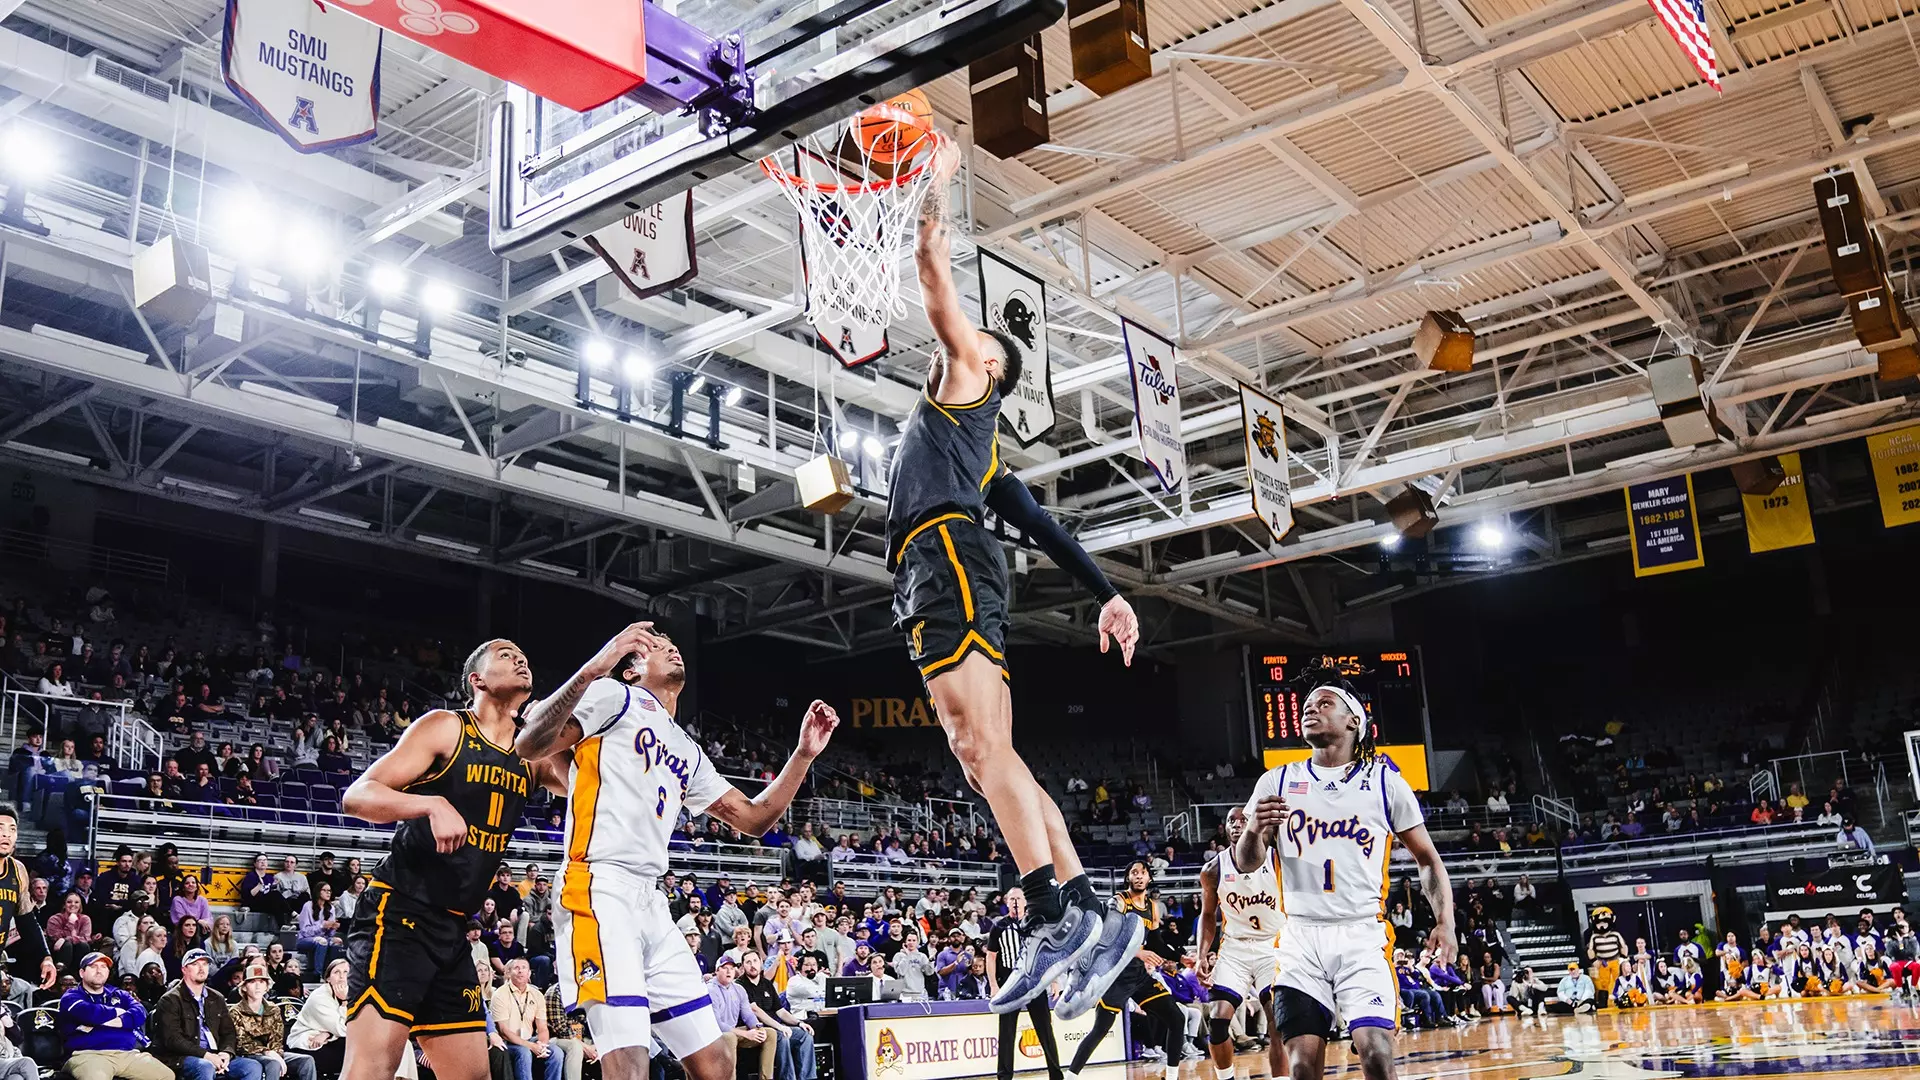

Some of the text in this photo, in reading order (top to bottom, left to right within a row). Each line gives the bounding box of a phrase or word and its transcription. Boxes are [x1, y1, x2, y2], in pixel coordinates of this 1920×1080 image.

[288, 28, 328, 62] SMU
[258, 41, 354, 98] MUSTANGS
[623, 216, 657, 240] OWLS
[1138, 361, 1175, 398] Tulsa
[1022, 385, 1044, 407] WAVE
[1648, 487, 1669, 499] MARY
[1763, 496, 1789, 510] 1973
[1650, 527, 1679, 538] 1ST TEAM
[1263, 655, 1287, 664] PIRATES
[1397, 663, 1410, 676] 17
[1271, 667, 1283, 680] 18
[1291, 692, 1297, 702] 2
[851, 697, 940, 728] PIRA
[466, 763, 527, 797] WICHITA
[486, 791, 504, 828] 11
[468, 824, 509, 853] STATE
[1287, 809, 1375, 860] Pirates
[1323, 858, 1335, 893] 1
[1226, 890, 1277, 914] Pirates
[1778, 886, 1805, 896] GROVER
[1249, 915, 1261, 930] 3
[905, 1036, 999, 1065] PIRATE CLUB
